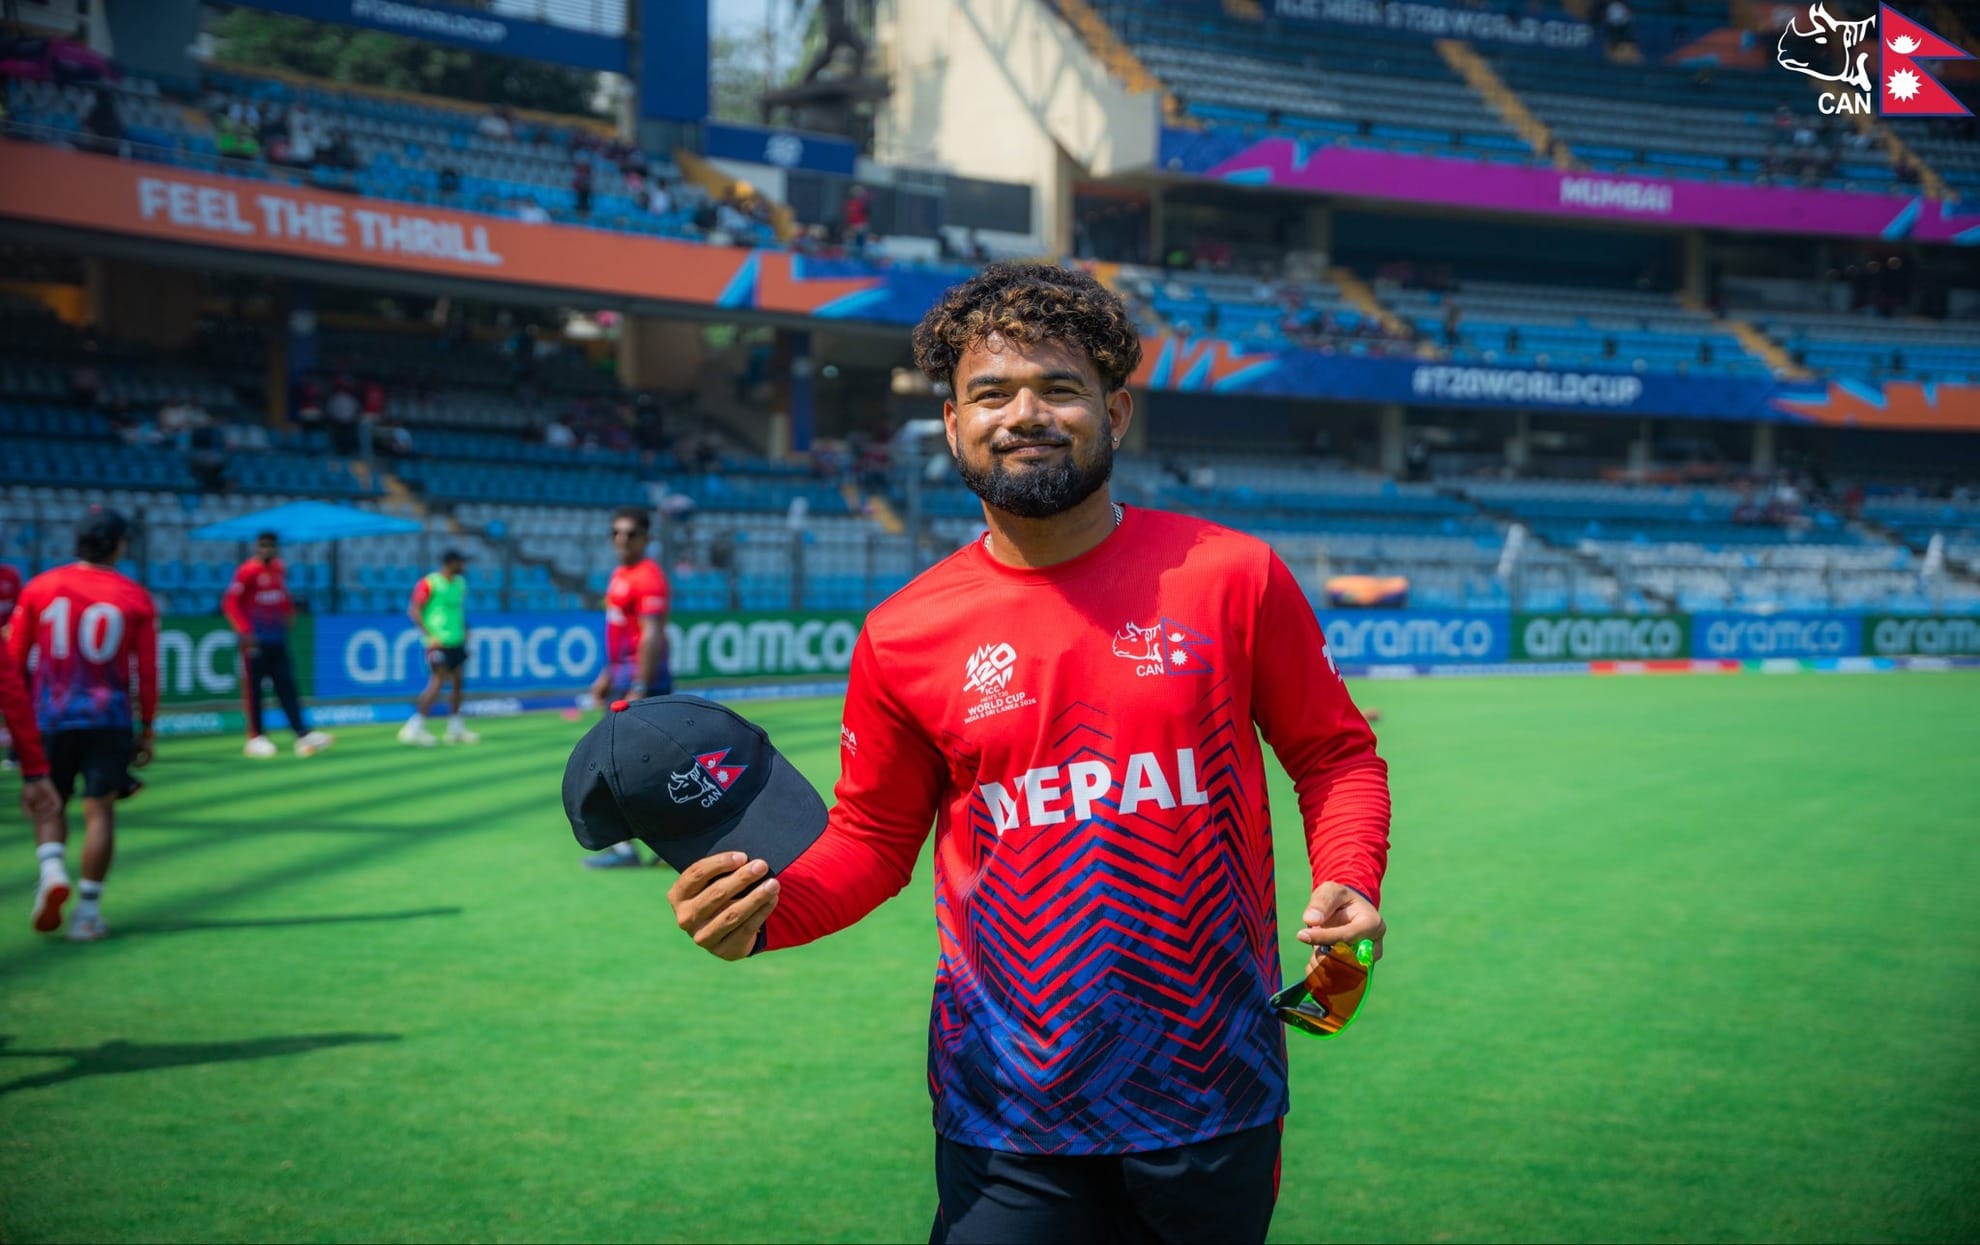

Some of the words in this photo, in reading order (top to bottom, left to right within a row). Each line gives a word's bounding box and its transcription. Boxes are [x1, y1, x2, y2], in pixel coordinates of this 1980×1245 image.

[1560, 176, 1673, 214] MUMBAI
[138, 177, 255, 235] FEEL
[256, 194, 347, 247] THE
[353, 209, 503, 266] THRILL
[1412, 366, 1642, 405] #T20WORLDCUP
[40, 596, 124, 664] 10
[1327, 619, 1492, 658] aramco
[1523, 619, 1682, 658] aramco
[1707, 620, 1844, 655] aramco
[1873, 619, 1980, 655] aram
[345, 626, 598, 683] armco
[1136, 663, 1164, 677] CAN
[968, 699, 1004, 716] WORLD
[1006, 692, 1026, 705] CUP
[985, 685, 1000, 696] ICC
[996, 703, 1019, 715] LANKA
[1020, 698, 1037, 707] 2026
[701, 788, 722, 809] CAN
[979, 748, 1209, 836] NEPAL
